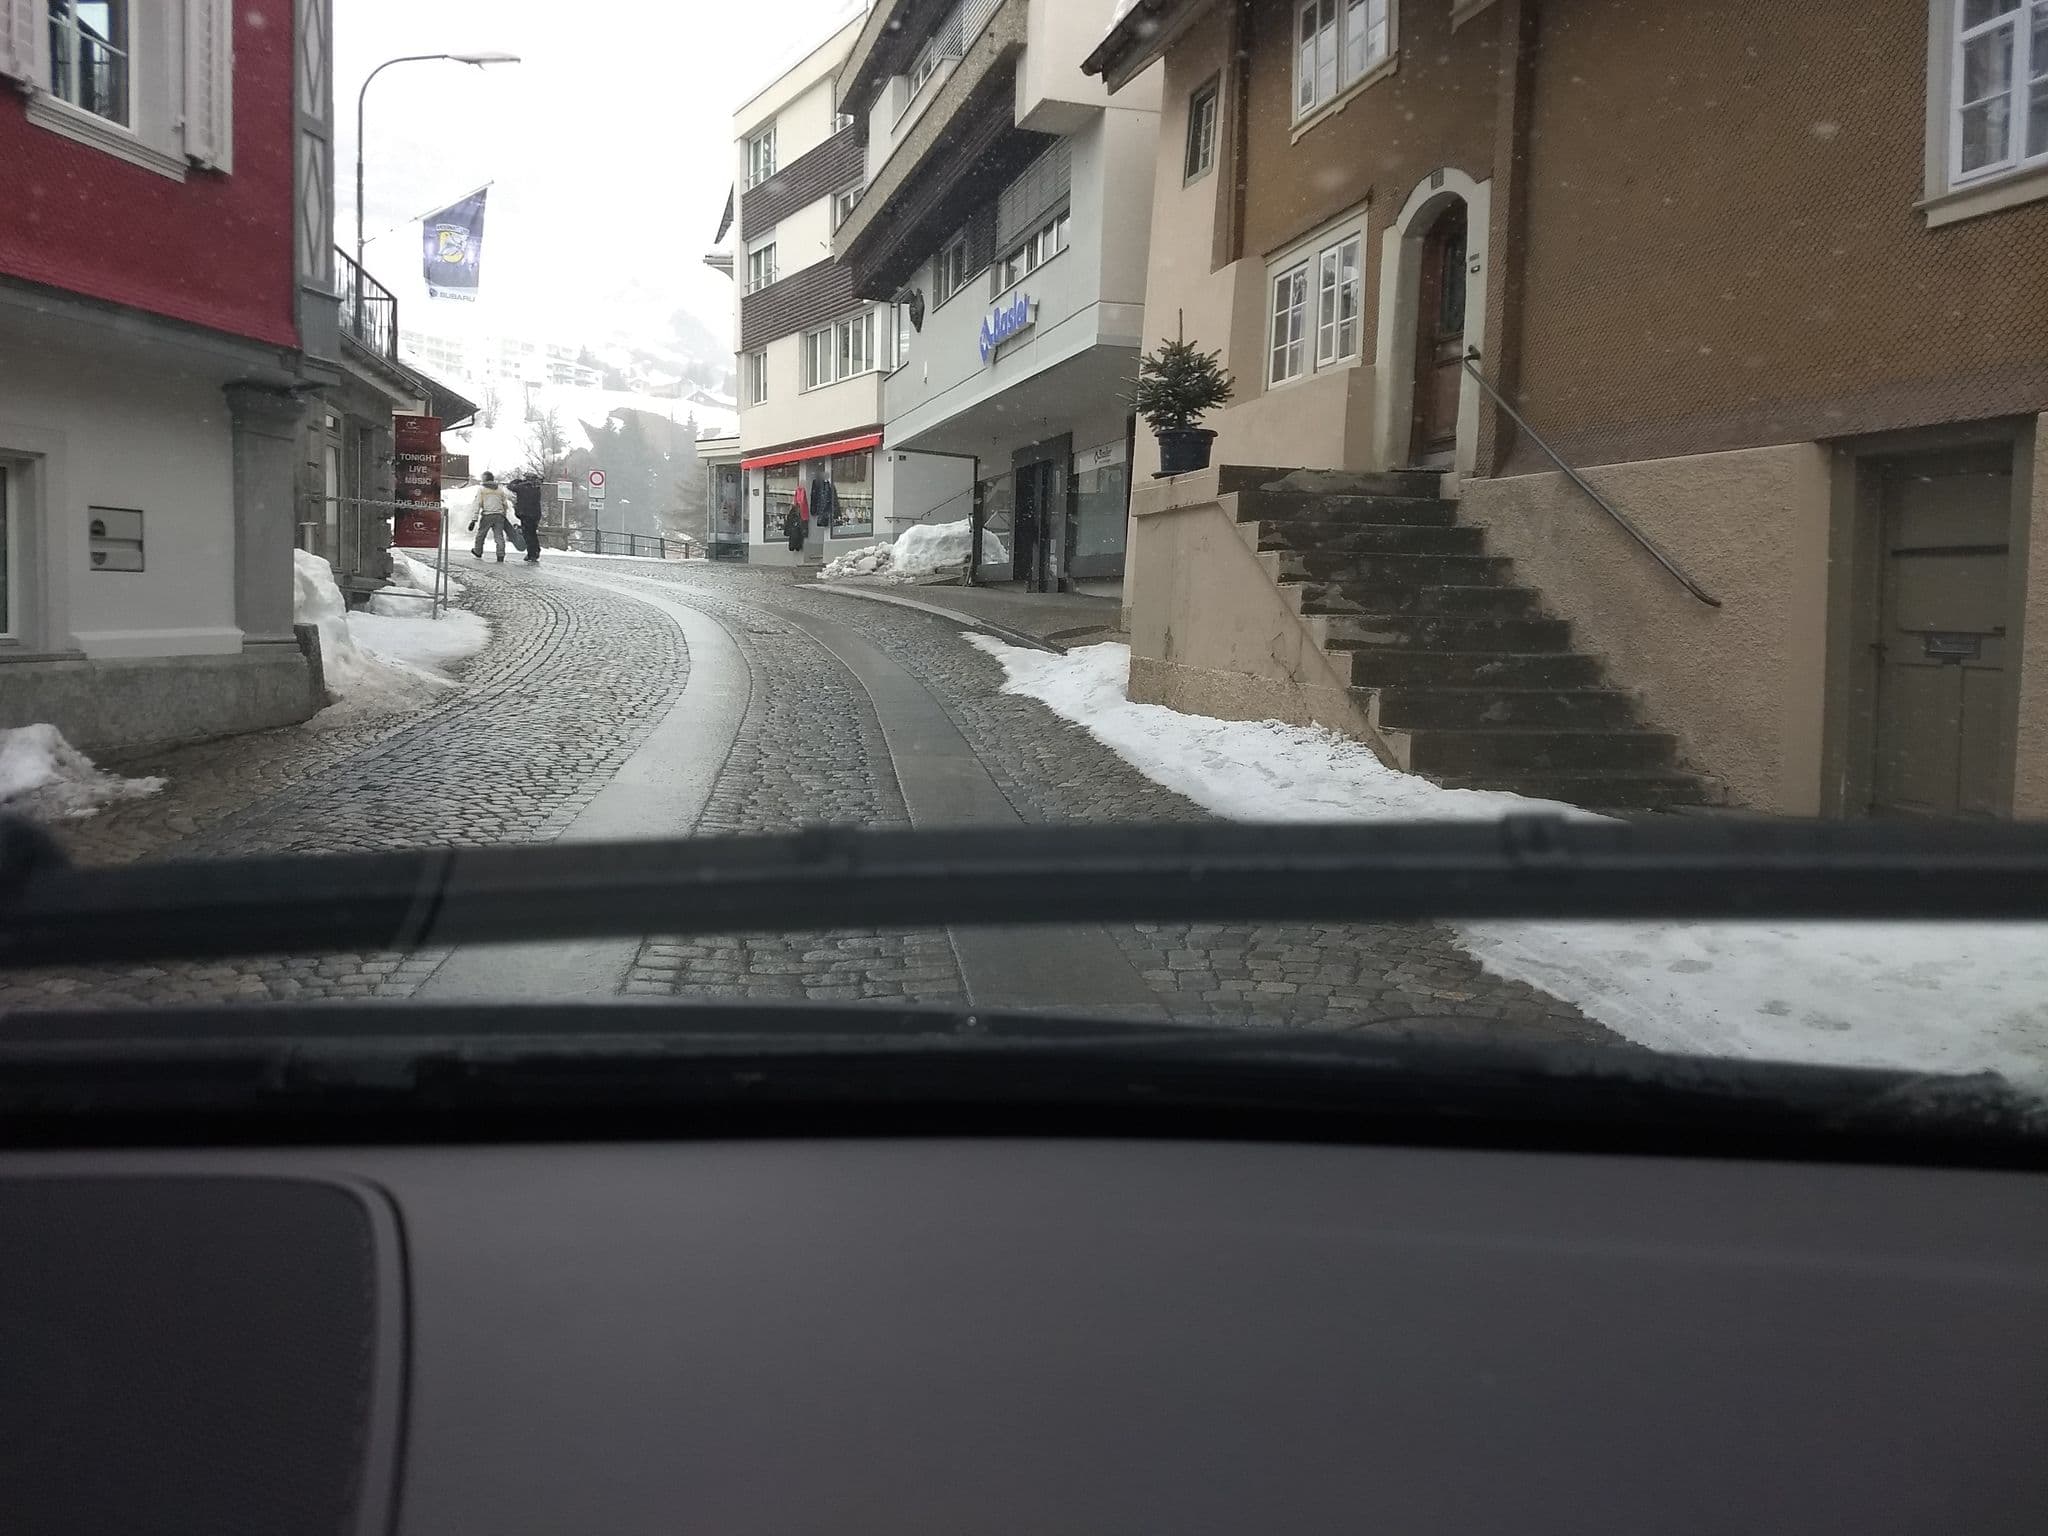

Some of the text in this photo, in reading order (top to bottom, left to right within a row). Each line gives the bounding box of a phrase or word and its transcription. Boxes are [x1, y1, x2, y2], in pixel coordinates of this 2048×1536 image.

[440, 291, 476, 302] SUBARU
[993, 290, 1030, 344] Basler
[400, 453, 437, 463] TONIGHT
[409, 465, 428, 474] LIVE
[405, 476, 432, 486] MUSIC
[396, 499, 441, 509] THE RIVER
